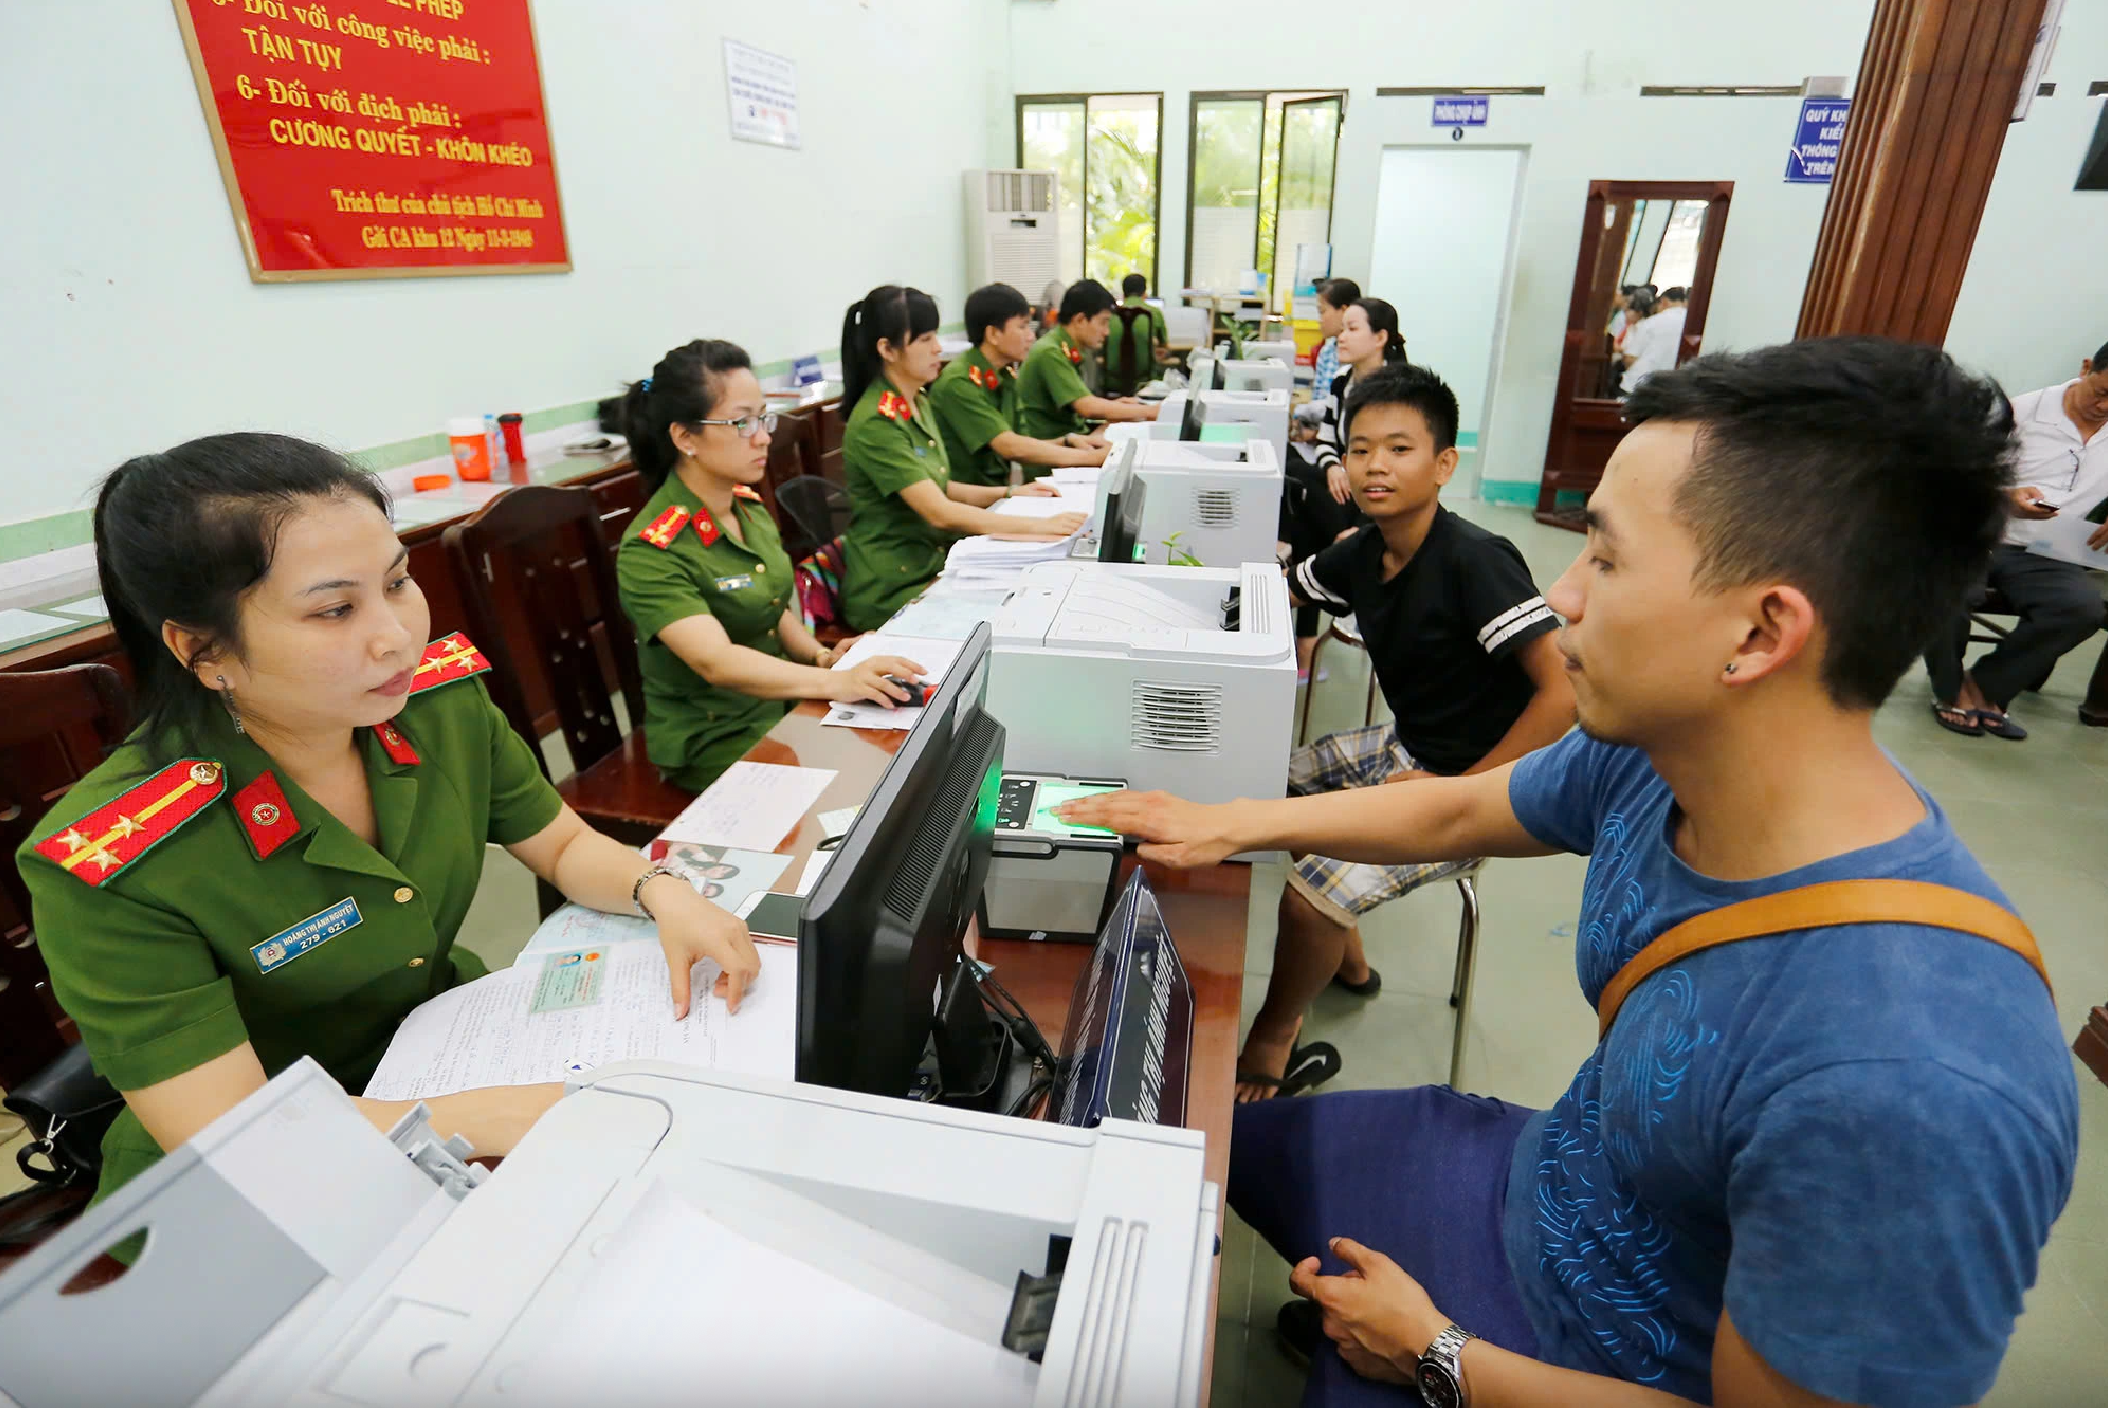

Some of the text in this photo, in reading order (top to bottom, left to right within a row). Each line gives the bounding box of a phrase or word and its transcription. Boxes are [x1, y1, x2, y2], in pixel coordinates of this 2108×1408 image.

[241, 24, 342, 72] TẬN TỤY
[293, 3, 332, 31] với
[337, 14, 390, 48] công
[393, 26, 435, 54] việc
[438, 36, 481, 62] phải
[265, 78, 312, 109] Đối
[315, 89, 355, 114] với
[358, 92, 404, 123] địch
[407, 102, 452, 128] phải
[1805, 106, 1832, 122] QUÝ
[270, 118, 351, 149] CƯƠNG
[355, 125, 421, 157] QUYẾT
[435, 136, 487, 163] KHÔN
[487, 142, 533, 167] KHÉO
[1801, 142, 1838, 158] THÔNG
